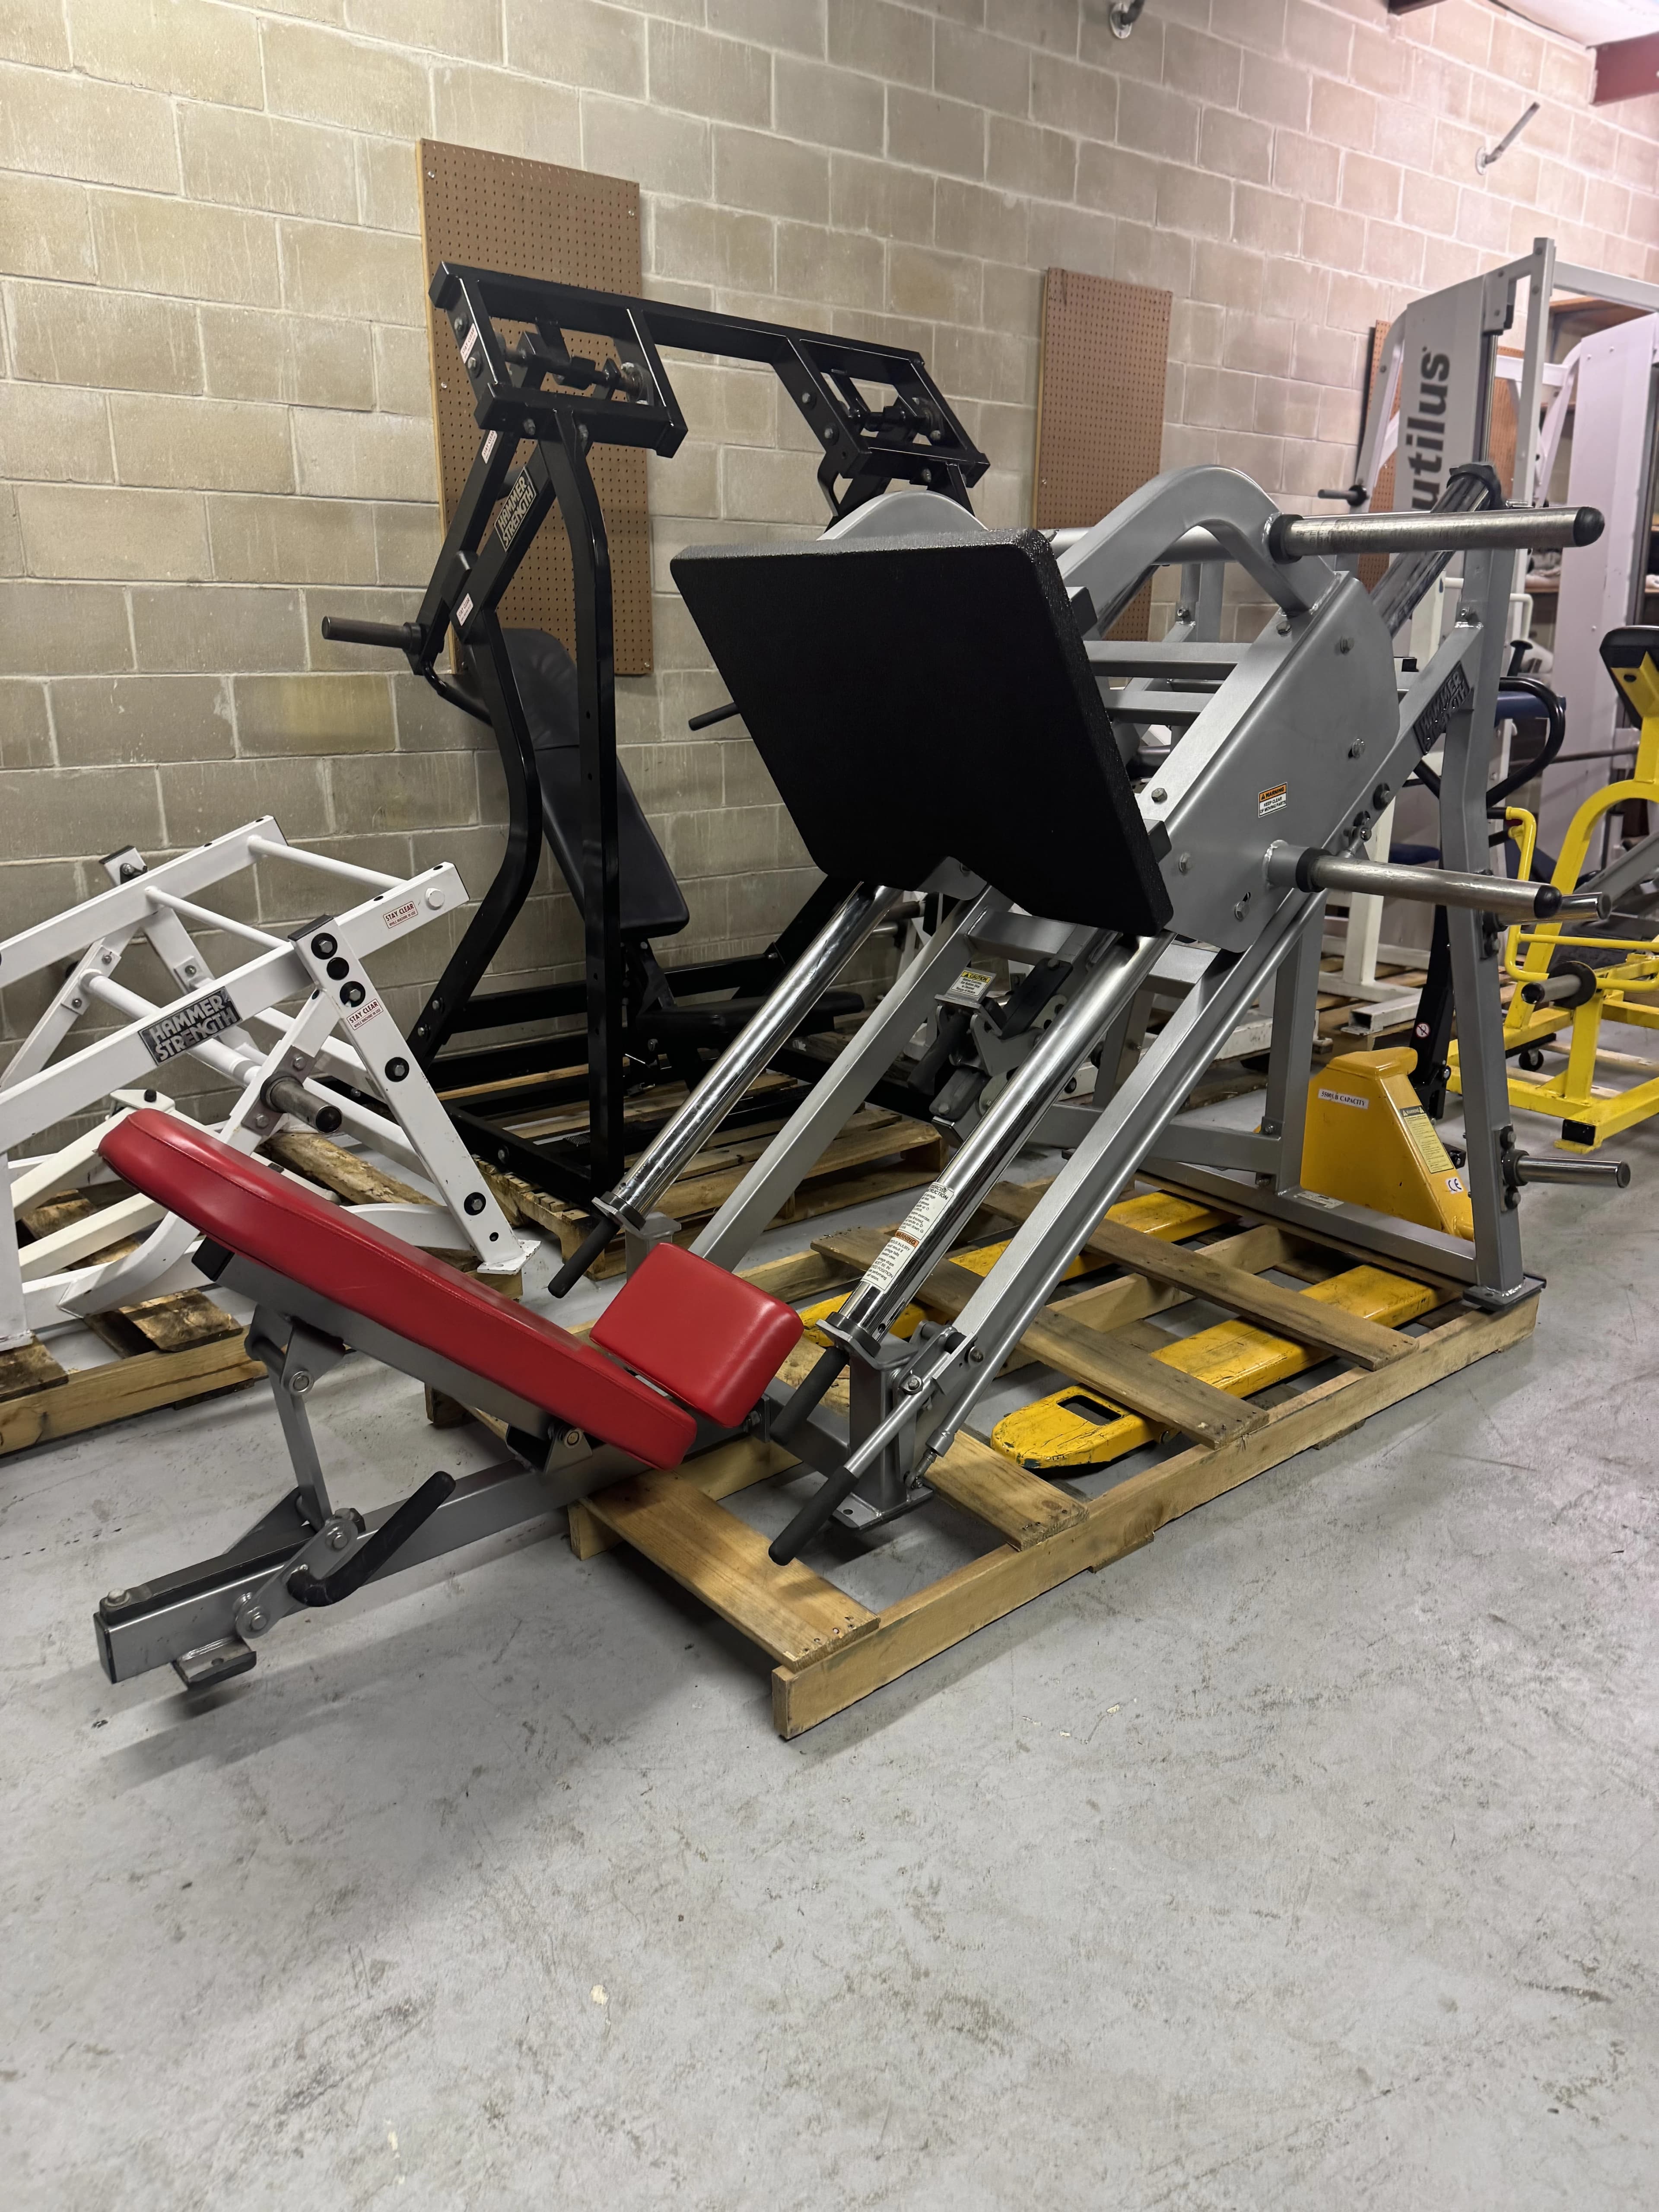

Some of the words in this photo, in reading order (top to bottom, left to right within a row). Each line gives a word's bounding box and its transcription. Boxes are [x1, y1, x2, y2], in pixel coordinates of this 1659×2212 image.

[498, 476, 527, 532] HAMMER
[503, 485, 534, 547] STRENGTH
[1265, 787, 1284, 798] WARNING
[385, 911, 398, 921] STAY
[399, 904, 414, 914] CLEAR
[149, 995, 225, 1045] HAMMER
[349, 1011, 362, 1023] STAY
[362, 1001, 378, 1014] CLEAR
[155, 1007, 237, 1061] STRENGTH
[1340, 1096, 1365, 1106] CAPACITY
